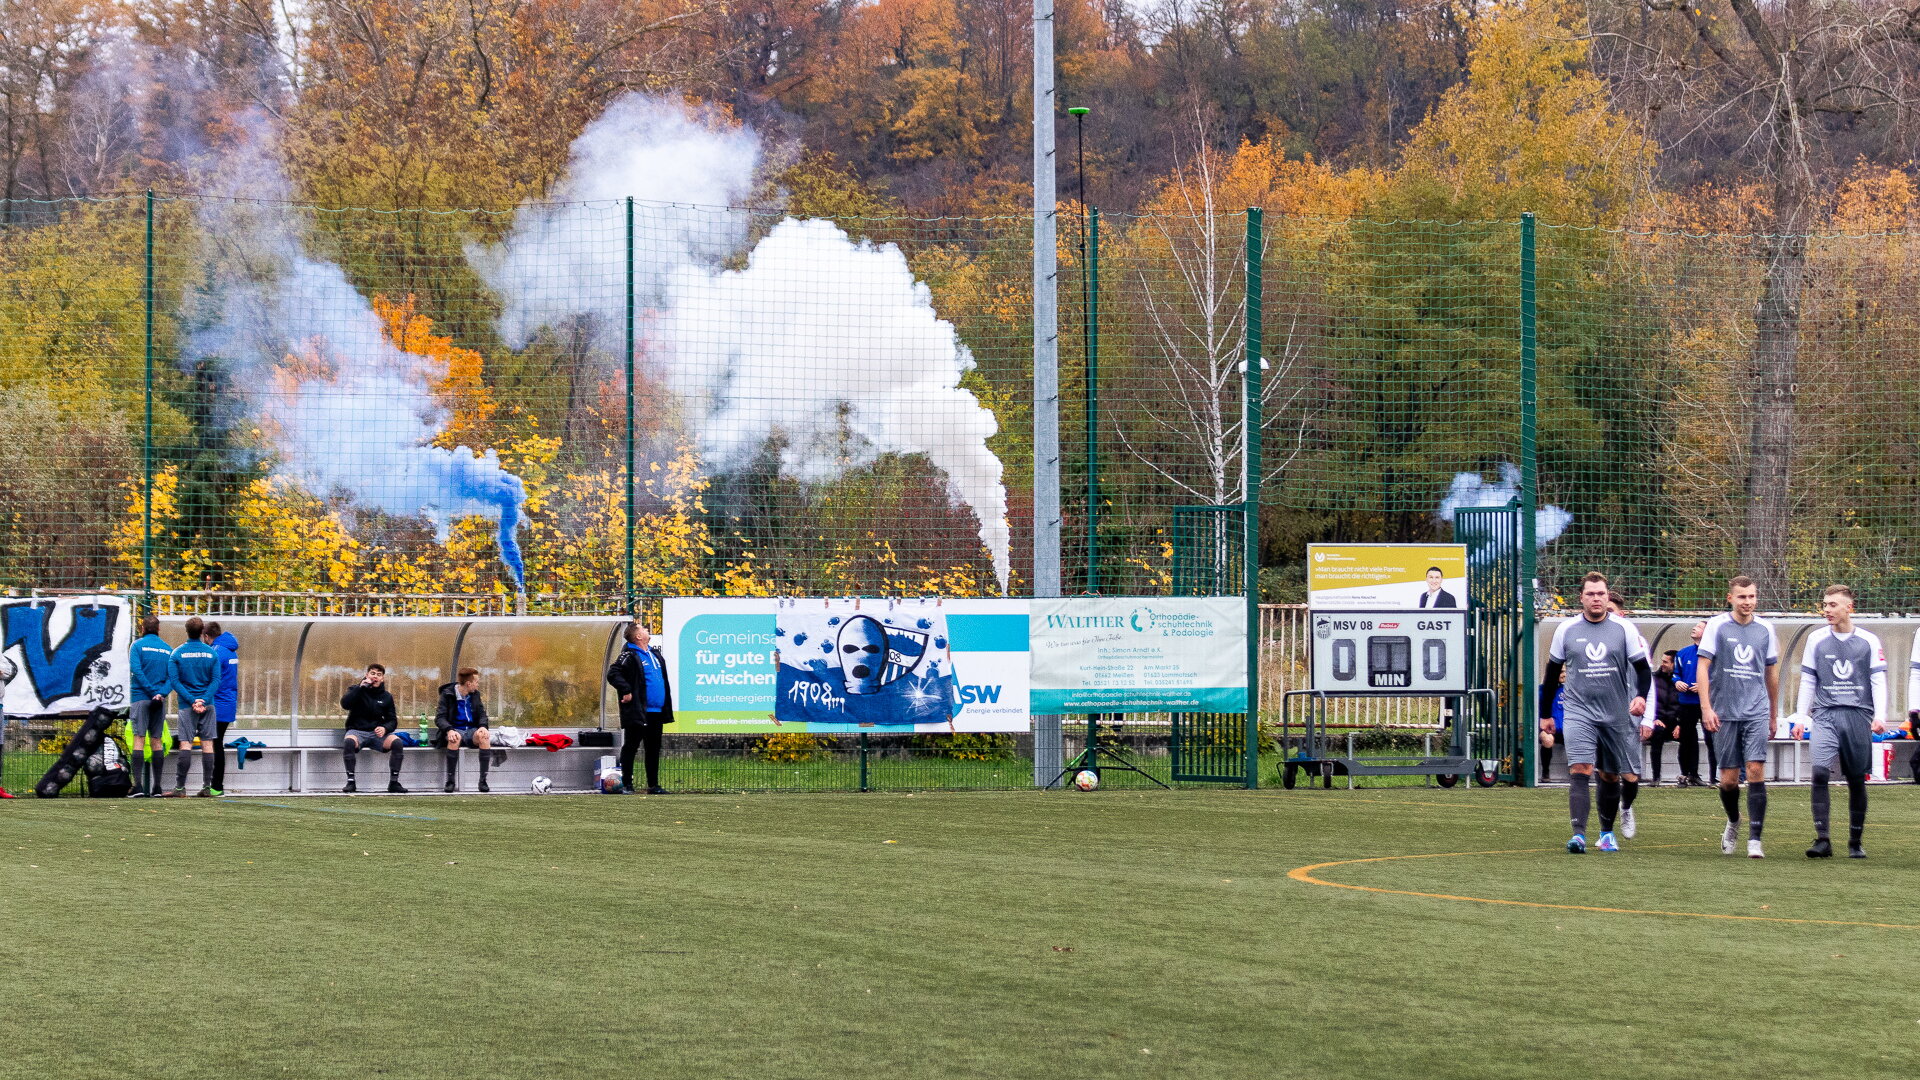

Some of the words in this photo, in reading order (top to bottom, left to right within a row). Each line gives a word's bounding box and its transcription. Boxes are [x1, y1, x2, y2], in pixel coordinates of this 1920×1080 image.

[1047, 614, 1124, 629] WALTHER
[1149, 613, 1199, 622] Orthopädie-
[1333, 621, 1357, 631] MSV
[1360, 620, 1373, 630] 08
[1417, 620, 1452, 631] GAST
[1171, 629, 1214, 638] Podologie
[695, 650, 720, 665] für
[724, 651, 765, 668] gute
[889, 651, 902, 663] 08
[1332, 639, 1356, 681] 0
[1423, 639, 1446, 681] 0
[696, 670, 776, 685] zwischen
[1374, 673, 1405, 686] MIN
